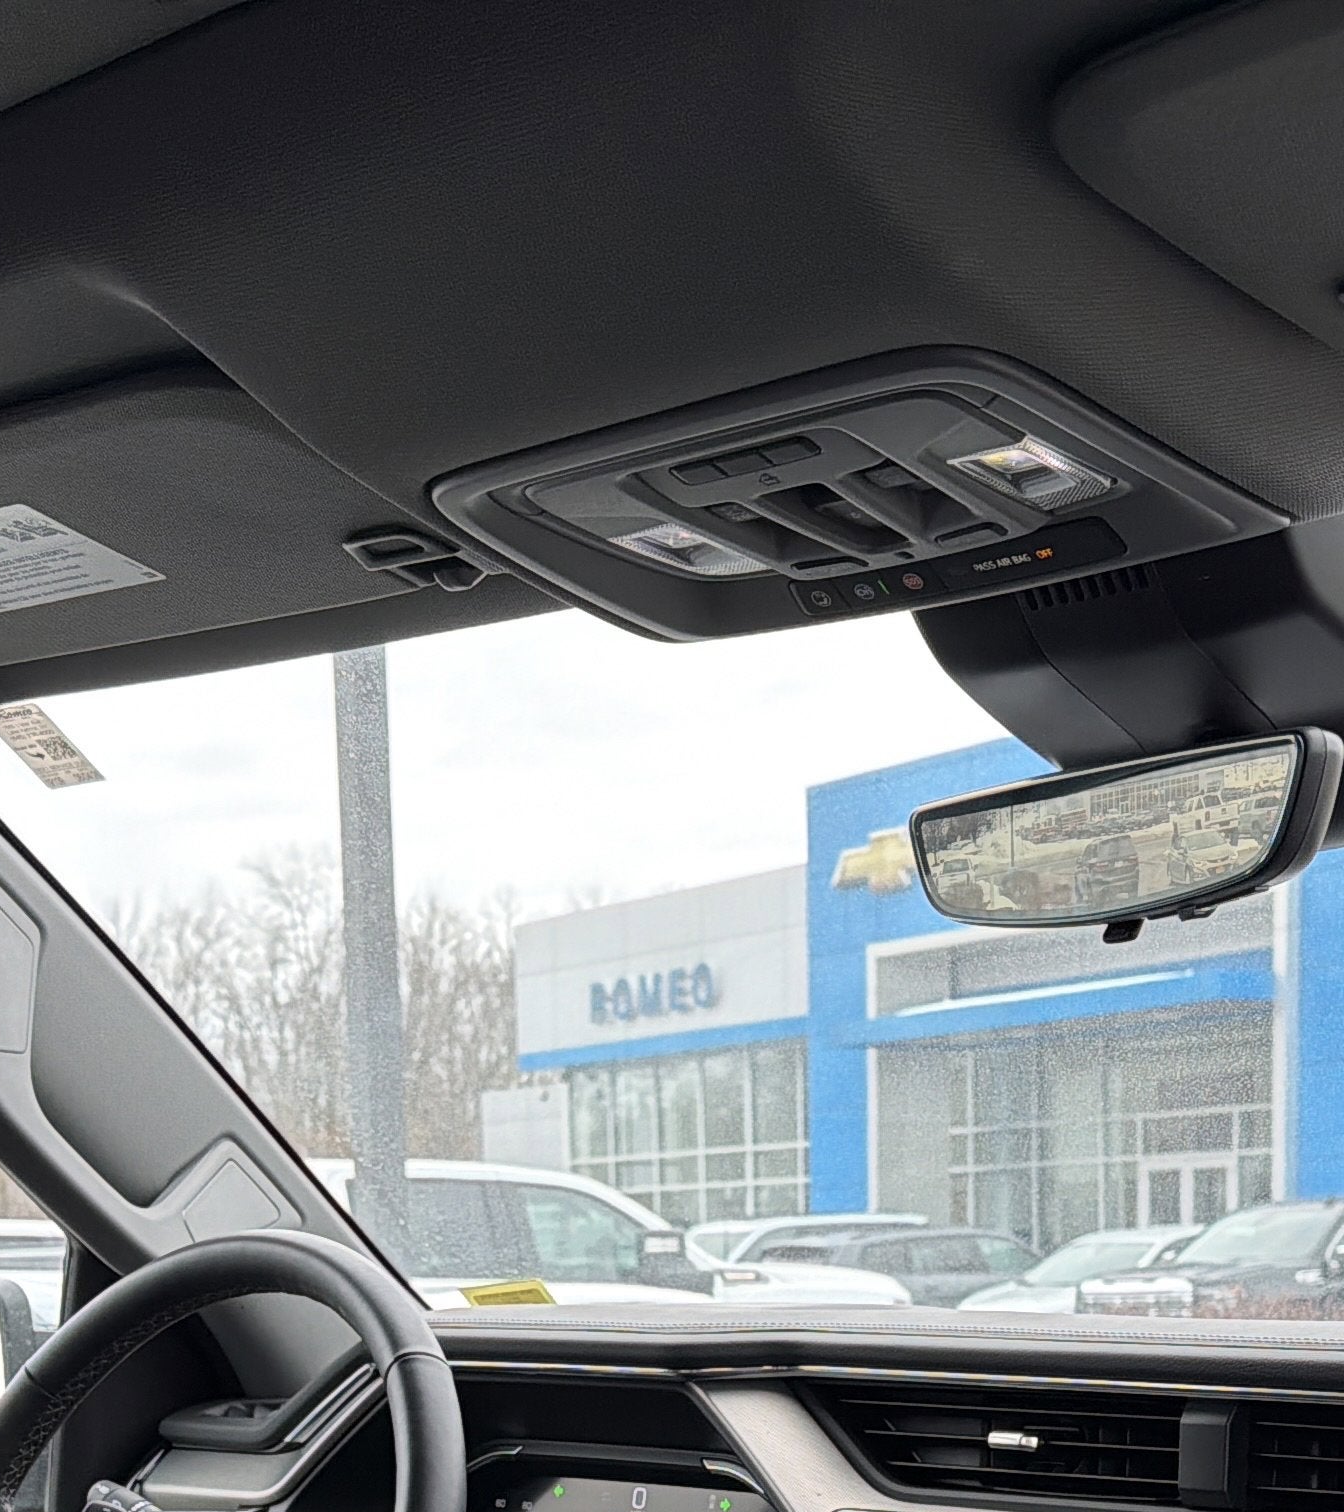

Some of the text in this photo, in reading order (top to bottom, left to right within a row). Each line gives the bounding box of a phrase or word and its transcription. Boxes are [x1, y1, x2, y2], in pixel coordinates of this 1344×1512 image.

[973, 547, 1054, 573] PASS AIR BAG OFF
[589, 962, 715, 1025] ROMEO
[632, 1486, 647, 1510] 0
